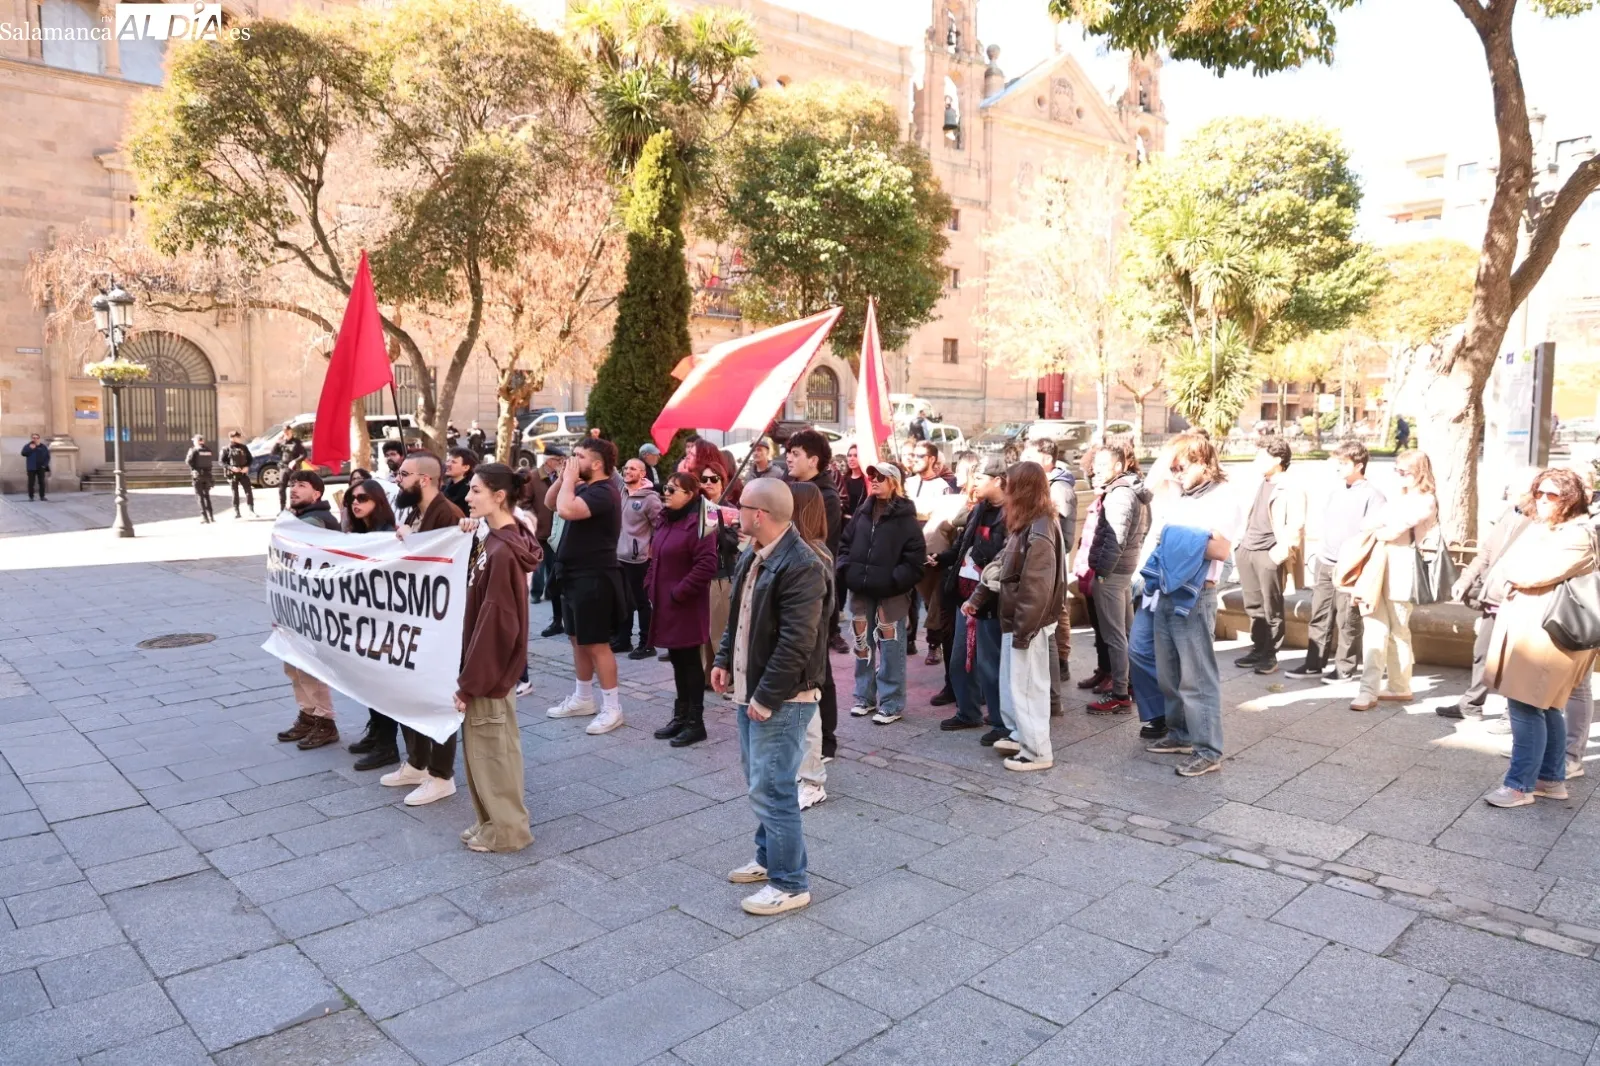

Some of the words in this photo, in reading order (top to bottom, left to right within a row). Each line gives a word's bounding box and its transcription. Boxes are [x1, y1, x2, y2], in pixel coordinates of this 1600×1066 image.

[338, 568, 451, 621] RACISMO
[270, 590, 322, 642] UNIDAD
[324, 608, 353, 652] DE
[355, 615, 422, 671] CLASE
